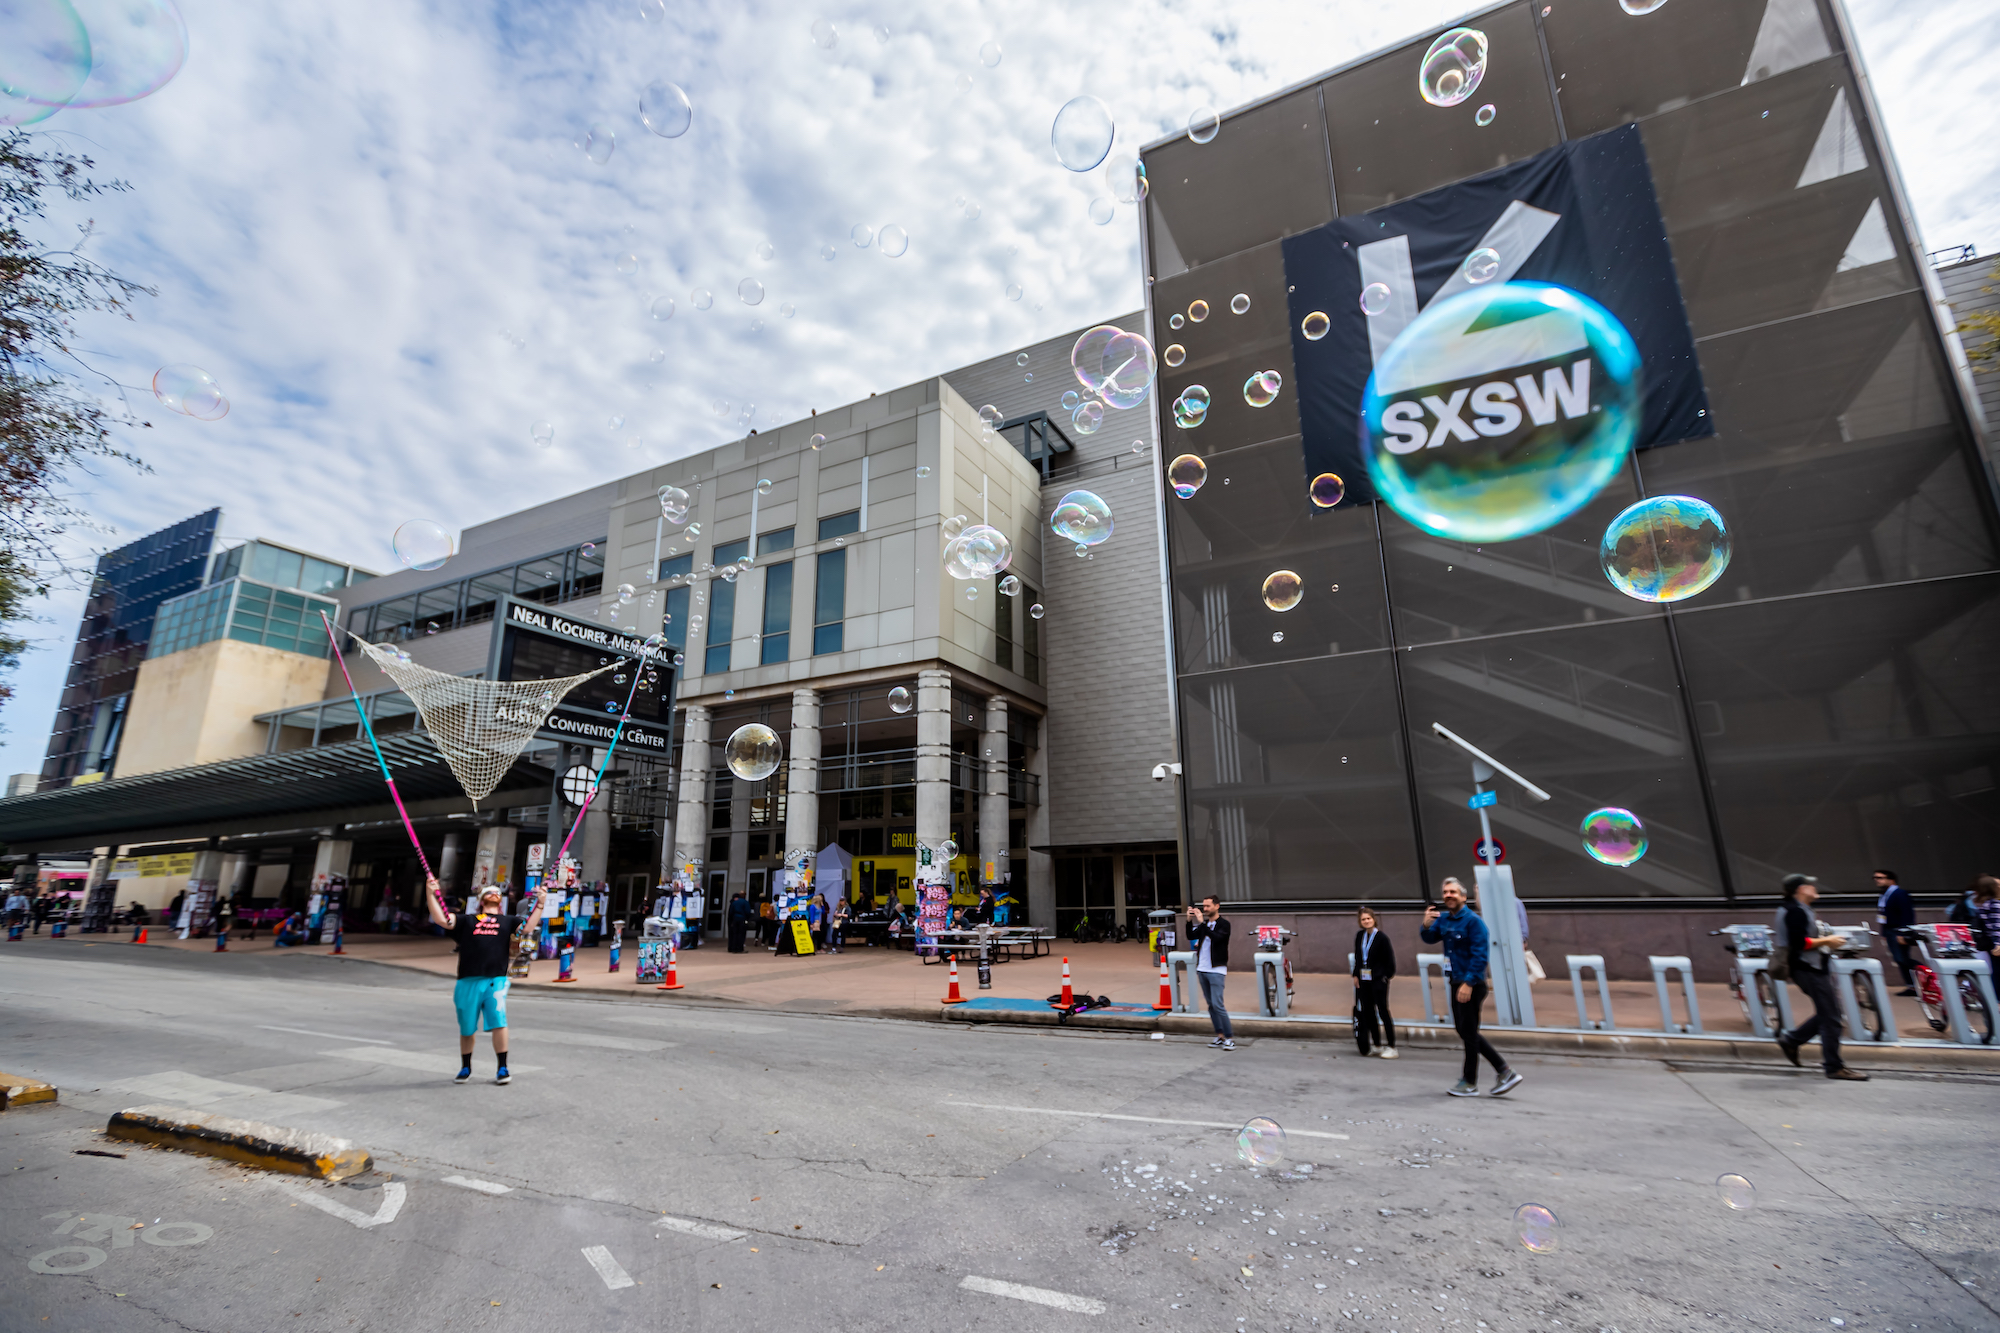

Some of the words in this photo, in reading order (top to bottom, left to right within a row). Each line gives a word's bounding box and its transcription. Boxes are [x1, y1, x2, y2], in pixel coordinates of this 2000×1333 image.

[1381, 358, 1591, 456] SXSW
[513, 605, 548, 629] NEAL
[551, 617, 607, 646] KOCUREK
[547, 715, 625, 741] CONVENTION
[626, 730, 665, 748] CENTER
